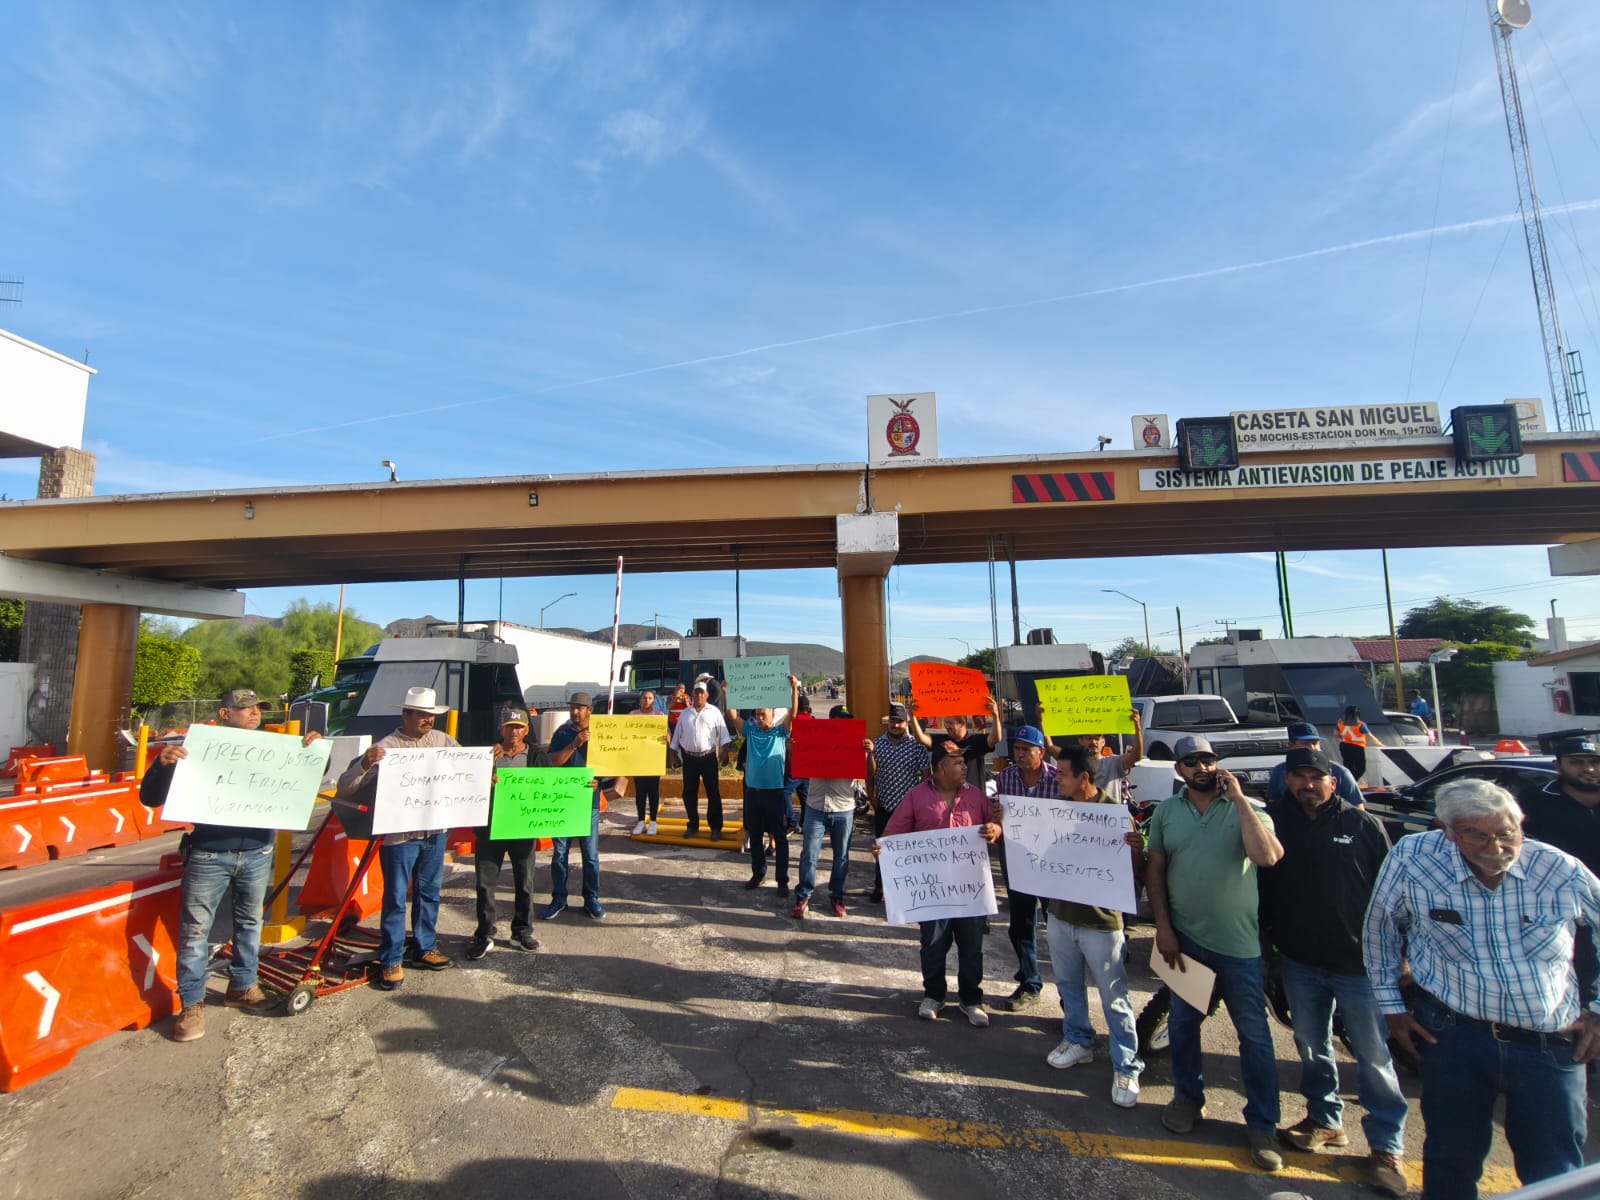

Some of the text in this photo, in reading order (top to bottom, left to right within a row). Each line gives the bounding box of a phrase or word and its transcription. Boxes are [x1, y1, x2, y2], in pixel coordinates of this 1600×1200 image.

[1236, 405, 1435, 431] CASETA SAN MIGUEL
[1237, 426, 1438, 443] LOS MOCHIS-ESTACION DON Km. 19+700
[1155, 457, 1521, 488] SISTEMA ANTIEVASION DE PEAJE ACTIVO
[1045, 683, 1057, 691] NO
[1064, 683, 1076, 691] AL
[202, 741, 275, 763] PRECIO
[388, 749, 491, 766] ZONA TEMPORAL
[216, 770, 304, 796] AL FRIJOL
[400, 772, 475, 787] SUMAMENTE
[503, 772, 586, 786] PRECIOS JUSTOS
[510, 790, 576, 803] AL FRIJOL
[528, 819, 566, 829] NATIVO
[1010, 824, 1022, 840] II
[884, 834, 969, 852] REAPERTURA
[894, 852, 947, 867] CENTRO
[1026, 852, 1115, 882] PRESENTES
[910, 881, 986, 907] YURIMUNY
